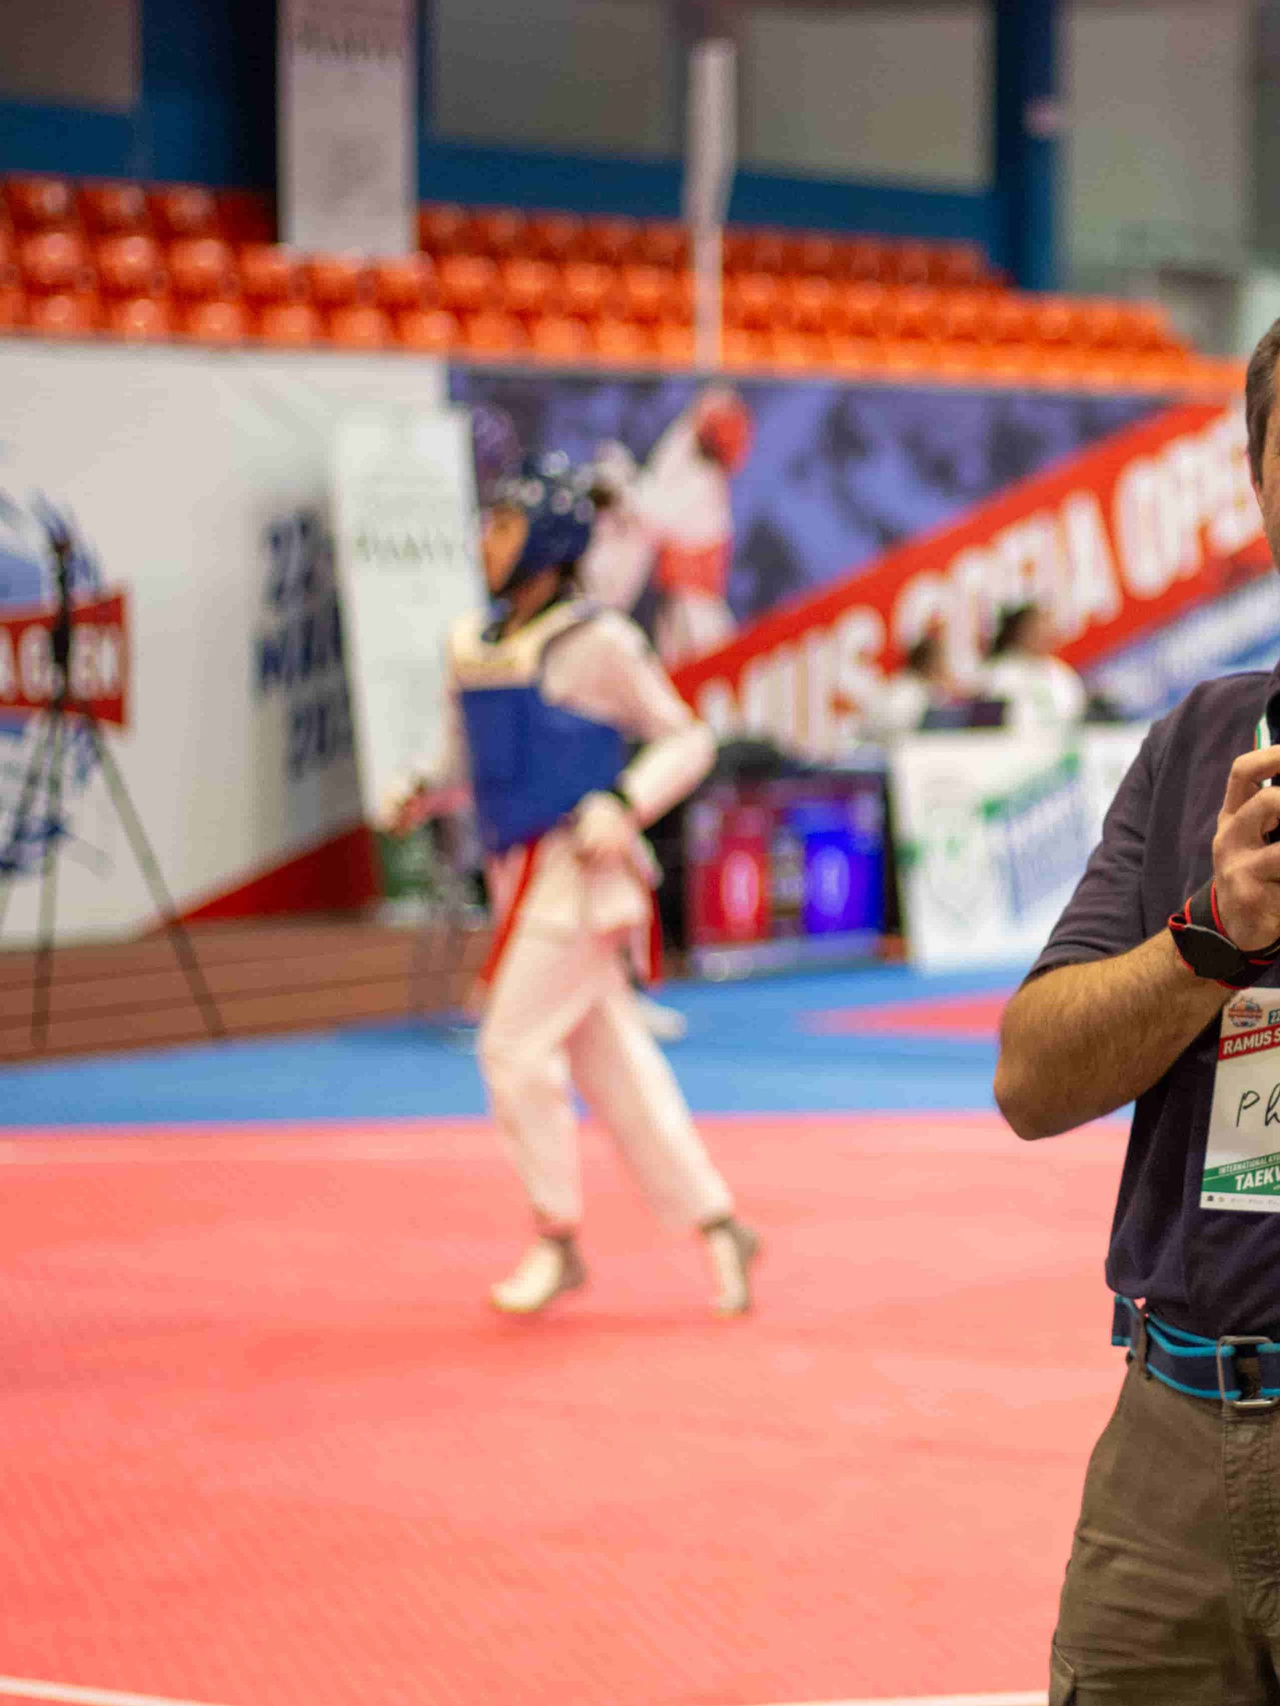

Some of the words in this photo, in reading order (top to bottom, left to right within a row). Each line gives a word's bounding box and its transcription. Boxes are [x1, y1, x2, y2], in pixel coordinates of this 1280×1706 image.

[1112, 395, 1266, 600] OPE
[1223, 1029, 1273, 1055] RAMUS
[1218, 1156, 1267, 1175] INTERNATIONAL
